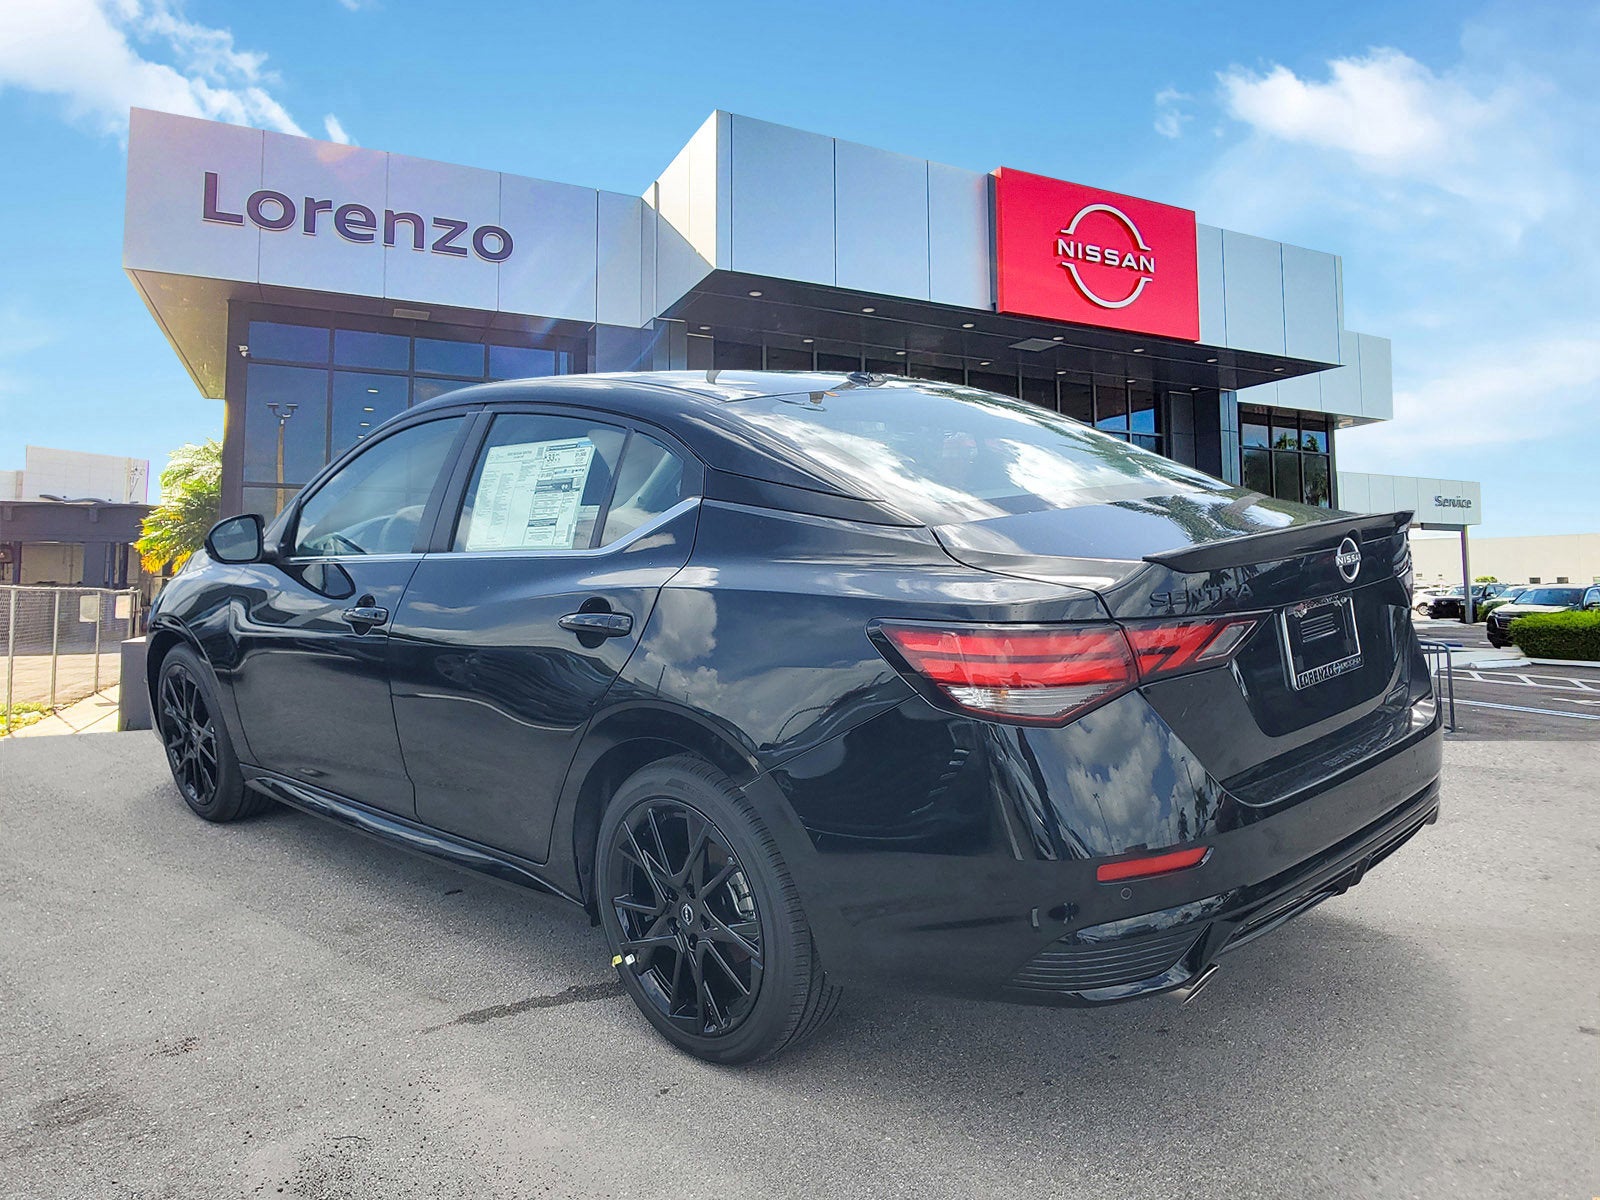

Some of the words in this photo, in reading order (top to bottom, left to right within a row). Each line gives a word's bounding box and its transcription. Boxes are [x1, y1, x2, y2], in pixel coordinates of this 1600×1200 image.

[203, 171, 514, 262] Lorenzo
[1057, 238, 1155, 273] NISSAN
[1434, 495, 1472, 508] Service
[1149, 583, 1254, 608] SENTRA
